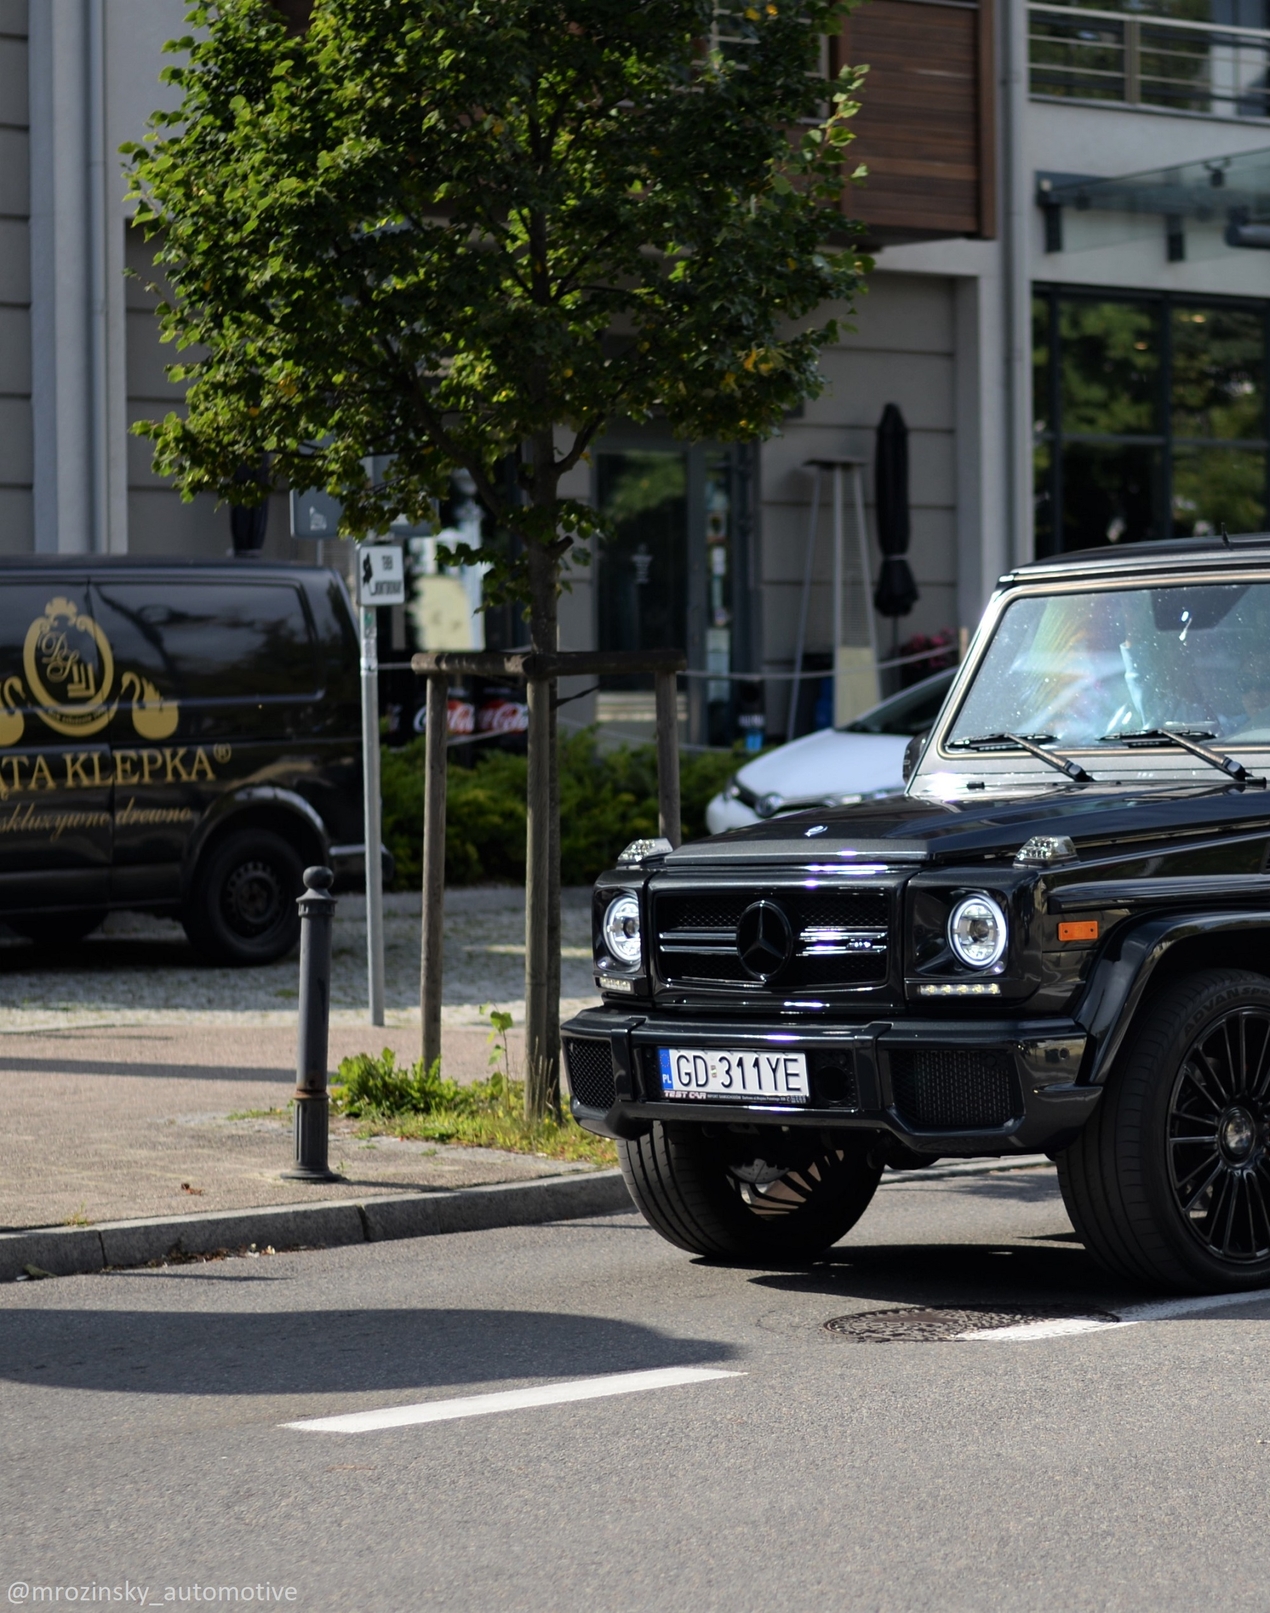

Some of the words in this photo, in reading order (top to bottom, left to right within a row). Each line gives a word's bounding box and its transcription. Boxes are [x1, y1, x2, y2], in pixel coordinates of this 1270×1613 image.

[676, 1054, 709, 1087] GD
[718, 1056, 801, 1092] 311YE
[662, 1074, 672, 1083] PL
[664, 1090, 688, 1098] TEST
